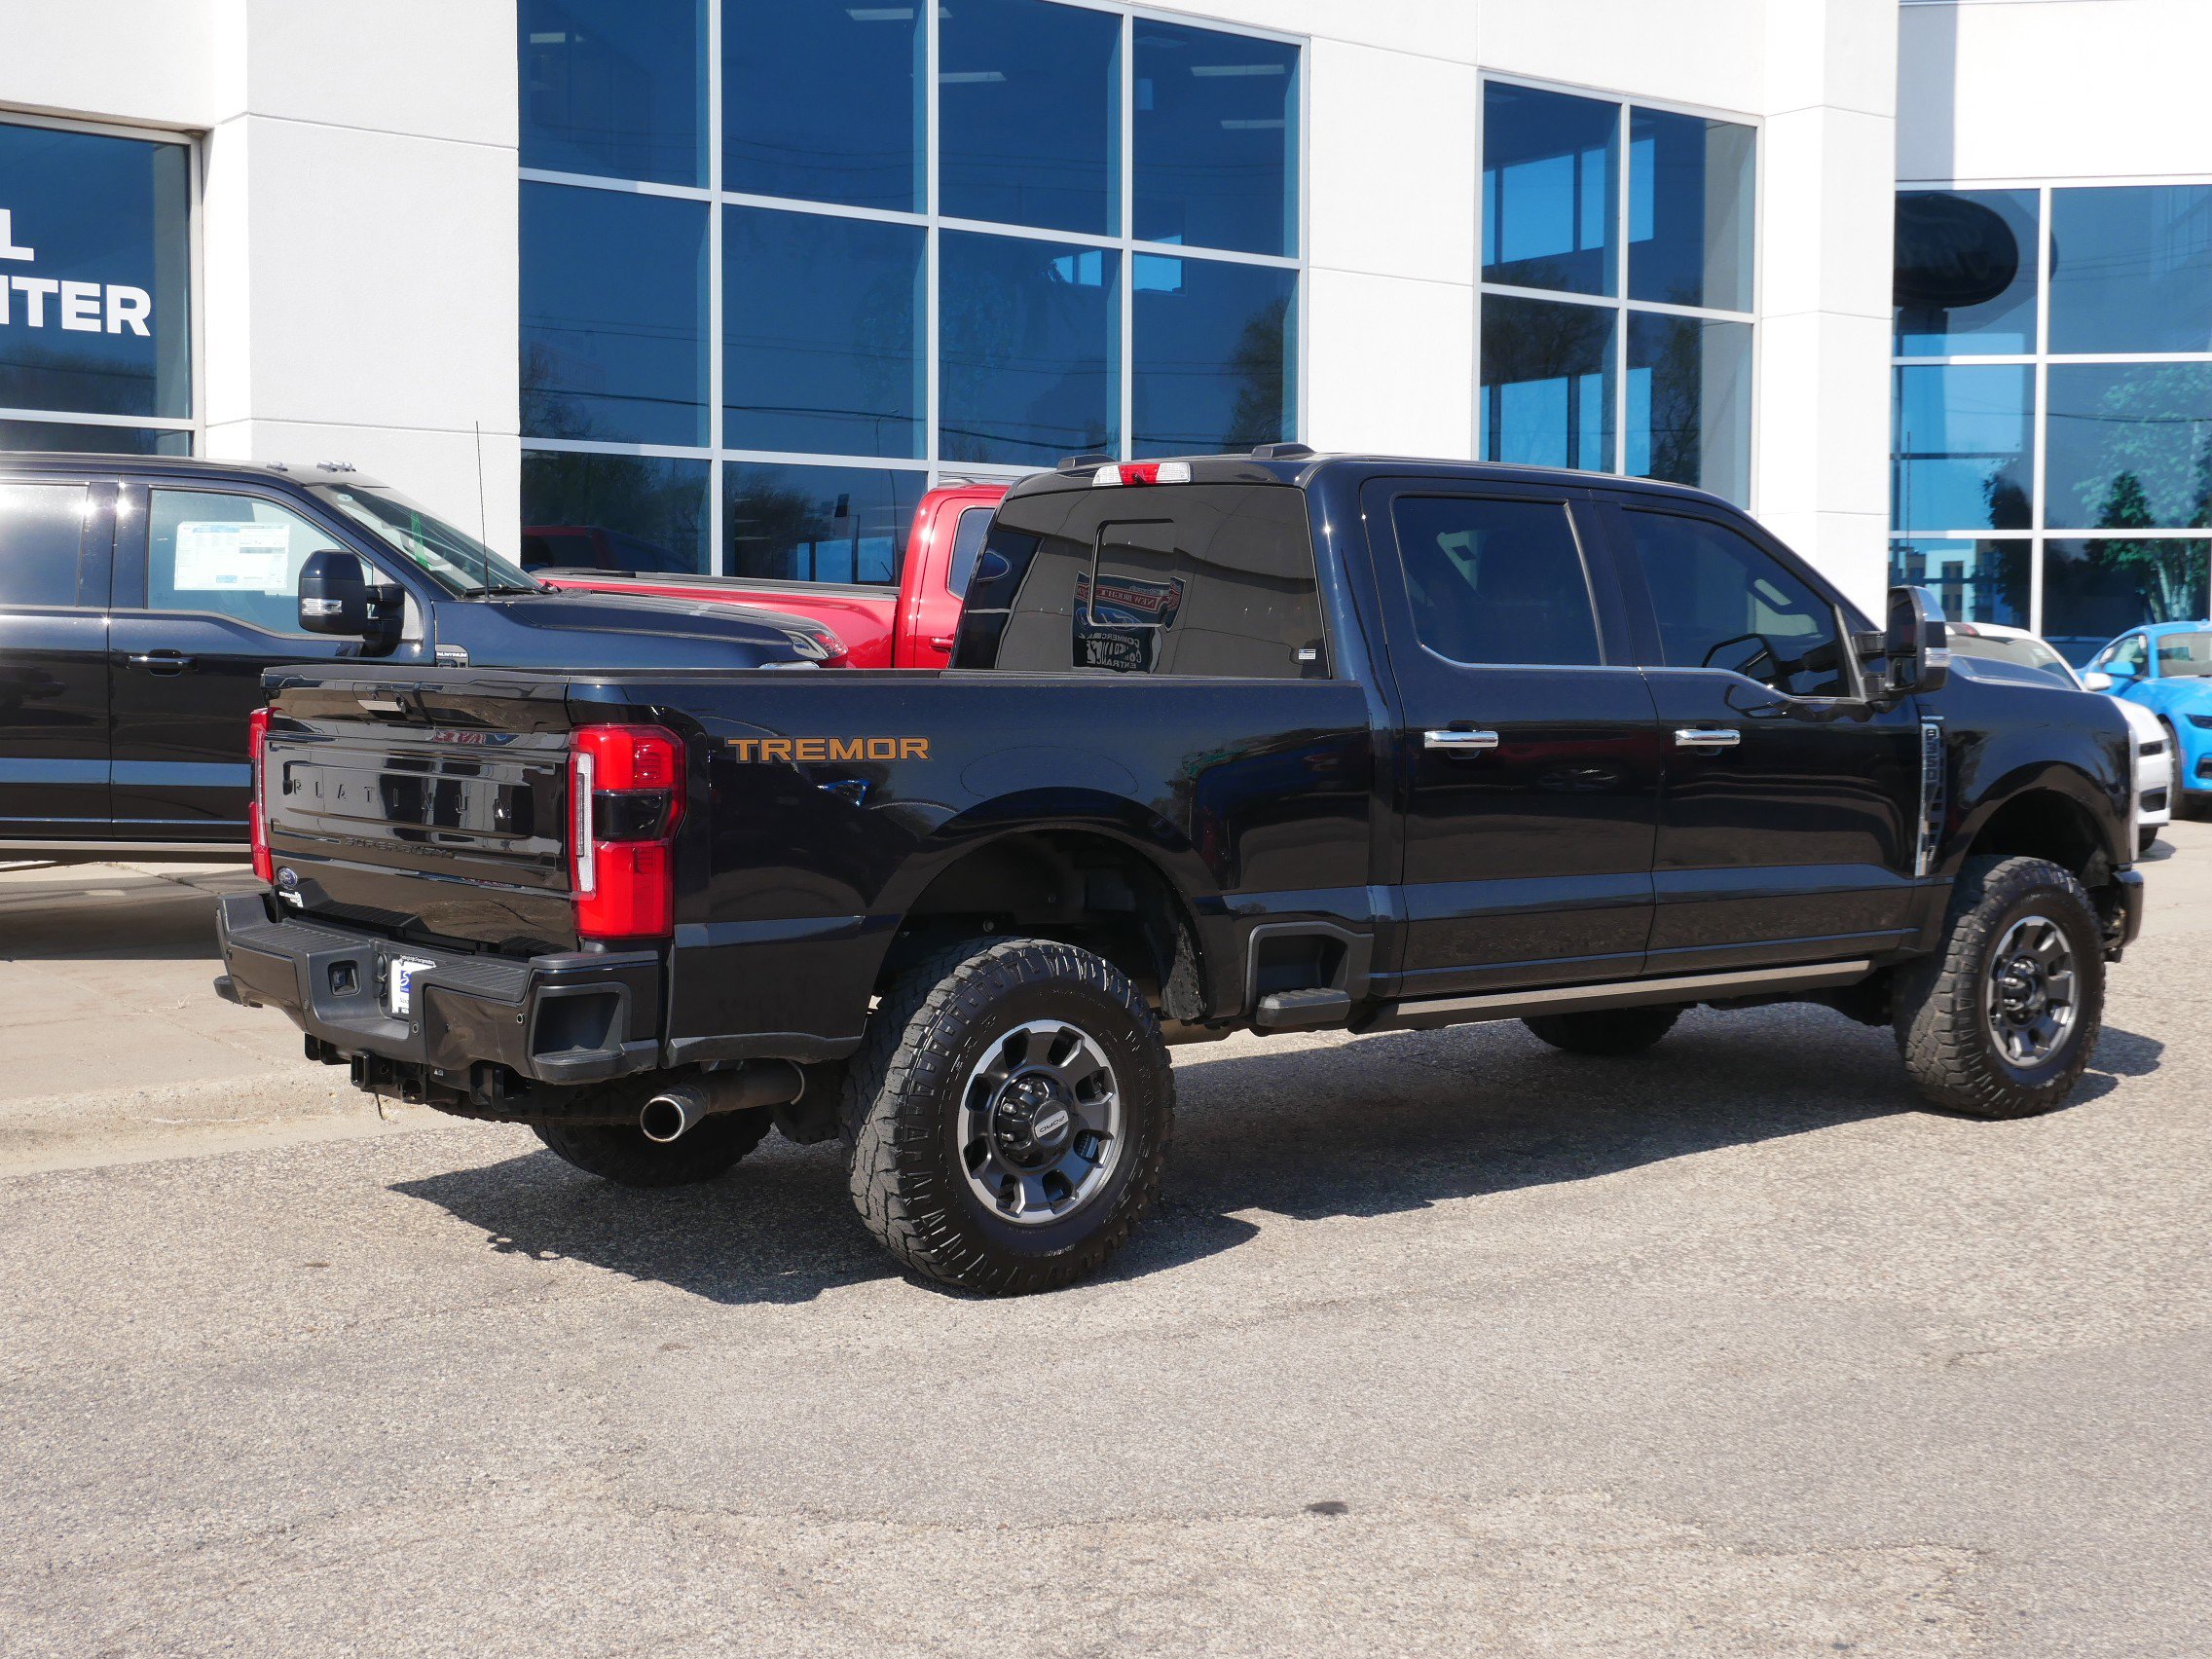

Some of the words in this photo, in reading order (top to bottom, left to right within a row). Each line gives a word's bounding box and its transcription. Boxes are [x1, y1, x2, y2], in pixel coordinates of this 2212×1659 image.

[0, 275, 151, 336] TER
[726, 737, 931, 762] TREMOR
[293, 779, 512, 819] PLATINUM
[1039, 1115, 1065, 1132] FORD
